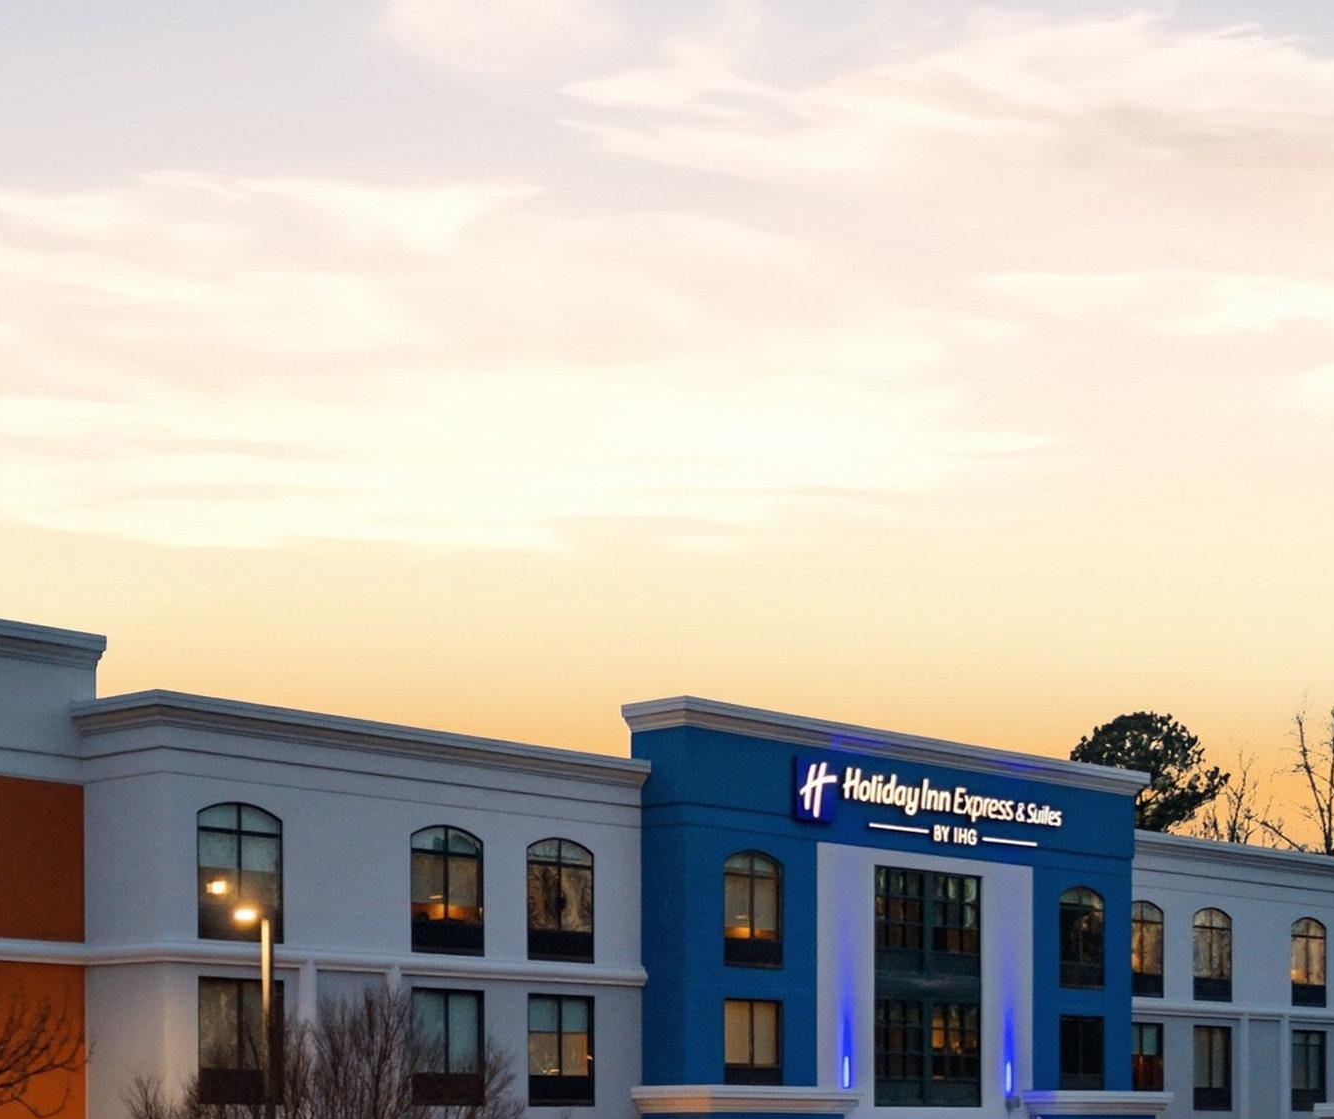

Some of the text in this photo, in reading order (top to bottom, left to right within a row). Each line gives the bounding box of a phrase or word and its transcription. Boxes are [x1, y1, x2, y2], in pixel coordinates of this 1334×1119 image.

[842, 766, 1063, 828] Holiday Inn Express & Suites
[933, 824, 979, 846] BY IHG
